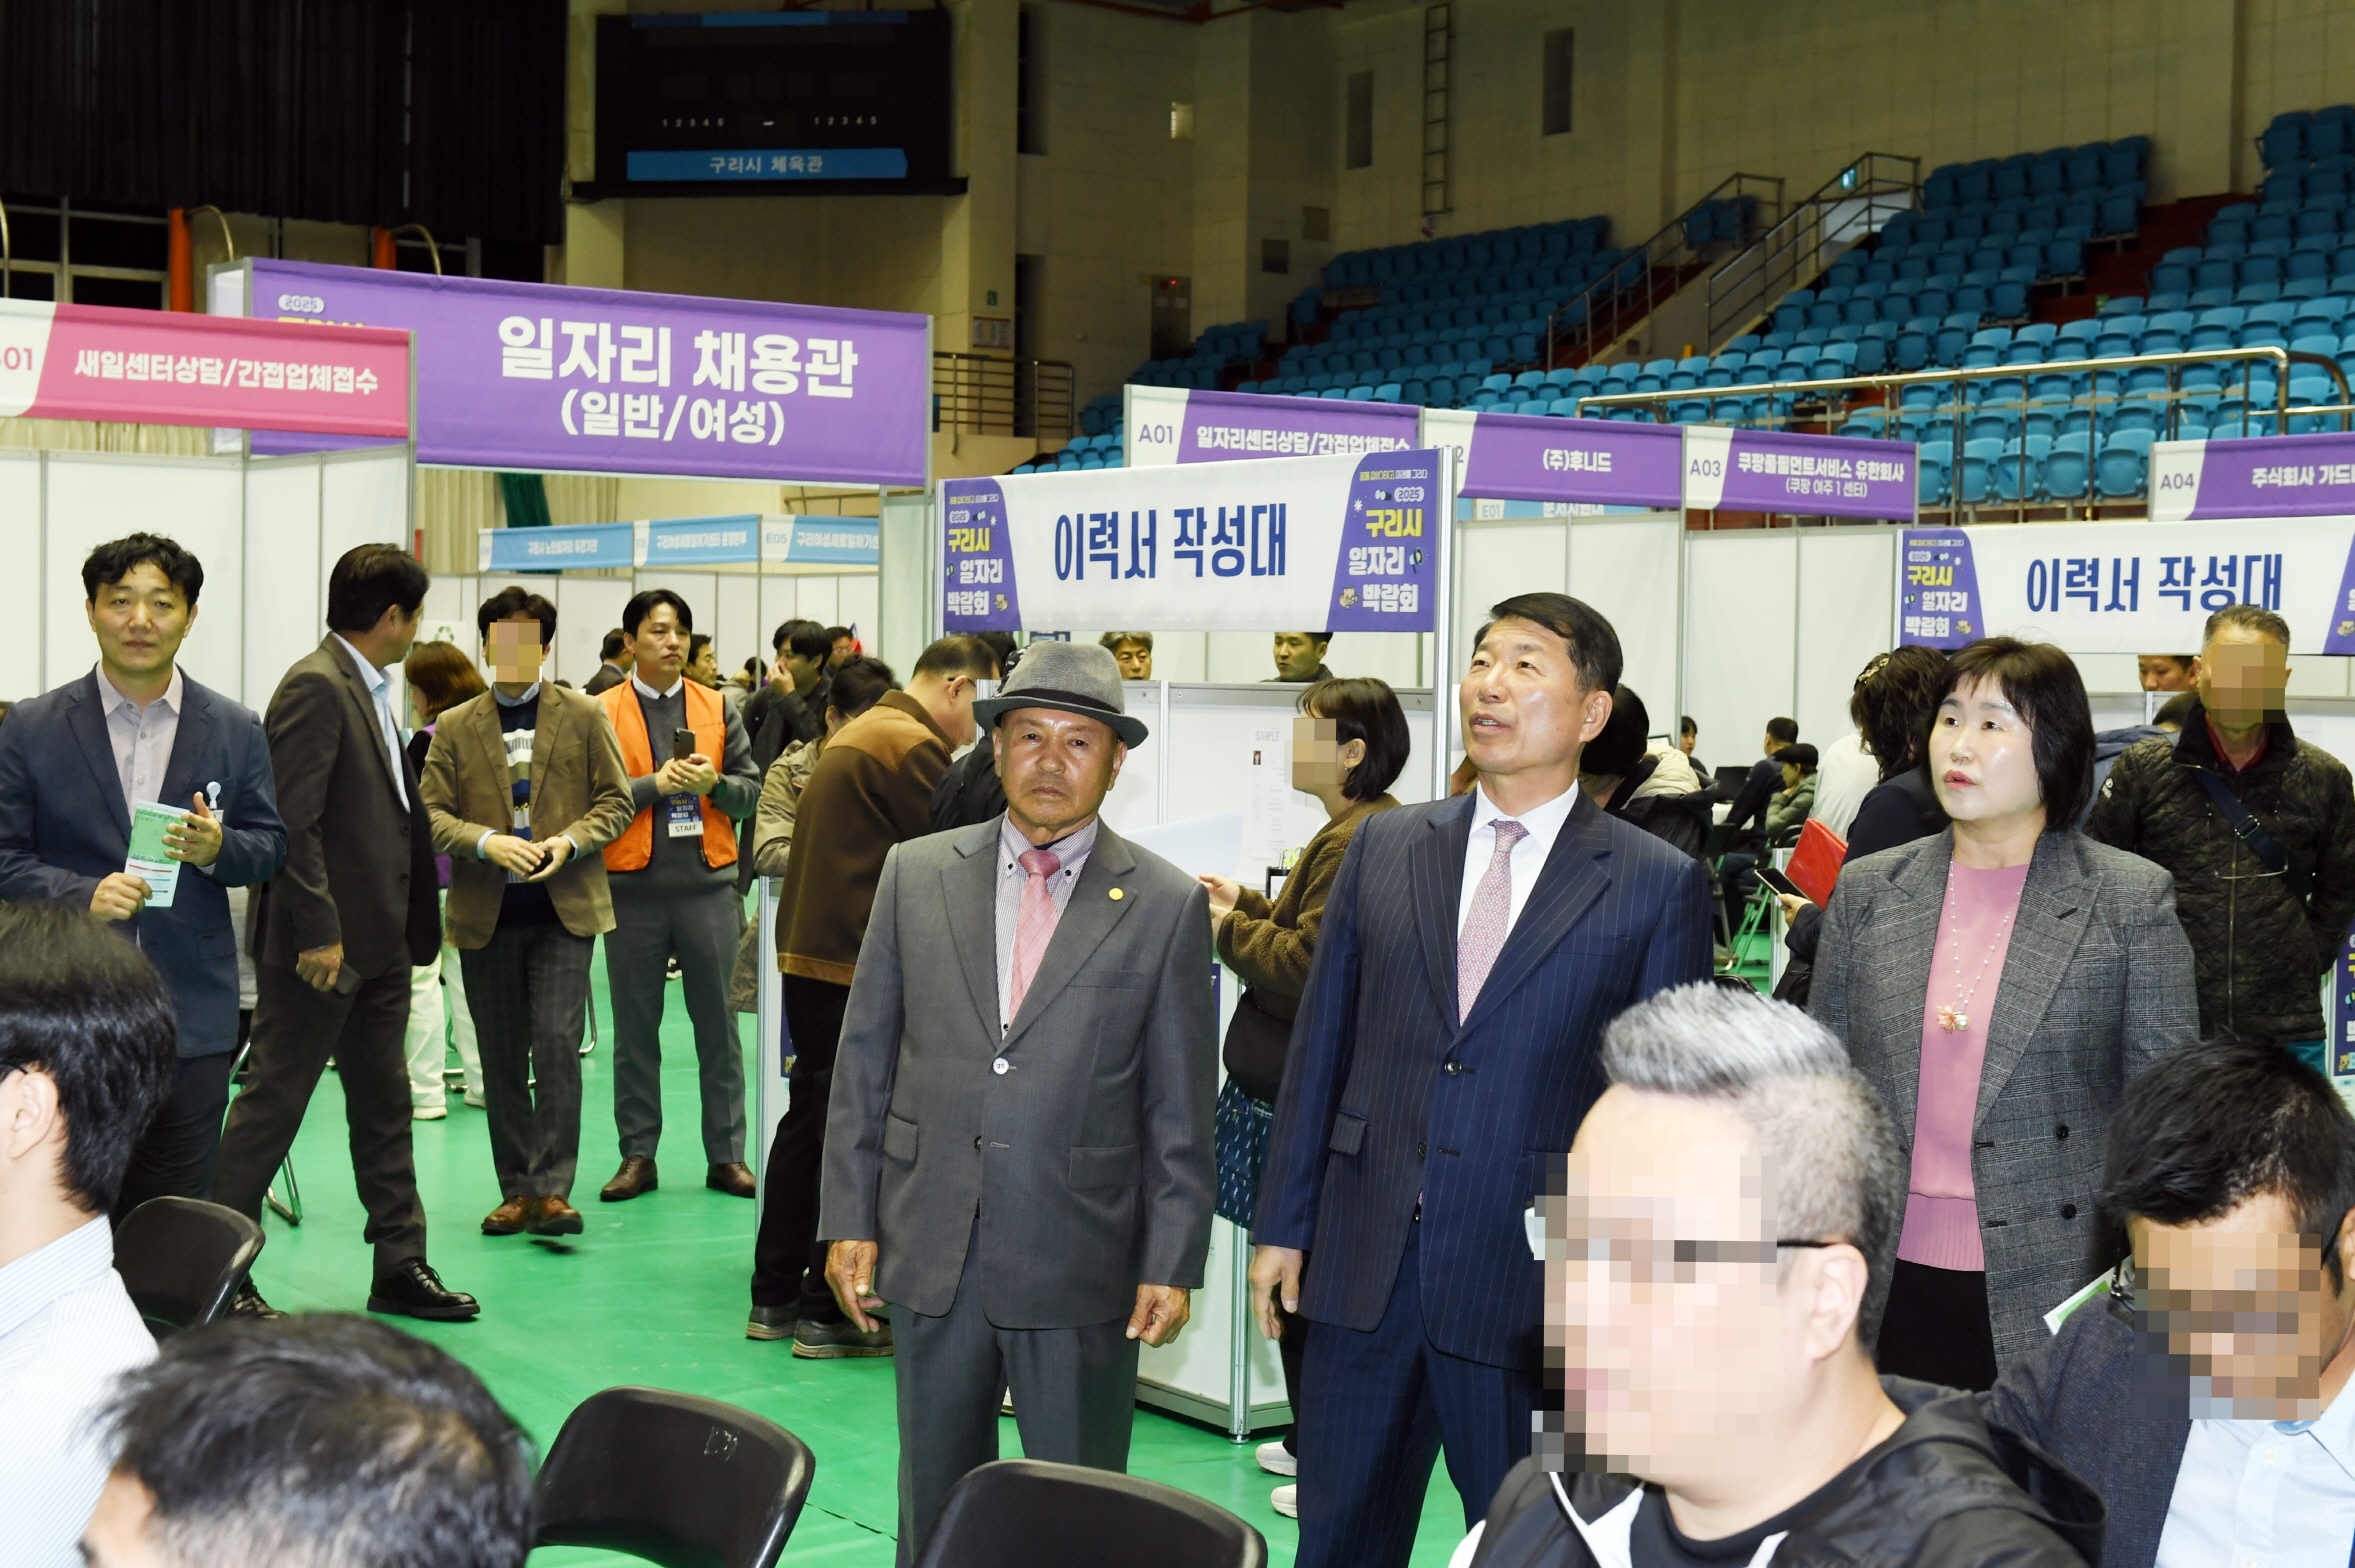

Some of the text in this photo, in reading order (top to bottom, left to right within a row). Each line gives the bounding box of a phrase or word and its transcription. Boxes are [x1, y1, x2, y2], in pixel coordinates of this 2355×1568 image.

[709, 155, 824, 174] 구리시 체육관
[498, 315, 859, 399] 일자리 채용관
[74, 350, 378, 395] 새일센터상담/간접업체접수
[560, 388, 786, 447] (일반/여성)
[1138, 424, 1174, 445] A01
[1542, 448, 1612, 472] (주)후니드
[1689, 459, 1721, 477] A03
[1737, 451, 1905, 482] 쿠팡풀필먼트서비스 유한회사
[1785, 476, 1811, 495] (쿠팡
[1843, 480, 1868, 498] 센터)
[2159, 473, 2195, 490] A04
[2251, 464, 2355, 489] 주식회사 가드
[1397, 488, 1422, 500] 2025
[1365, 508, 1423, 537] 구리시
[766, 532, 788, 544] E05
[948, 527, 990, 553] 구리시
[1054, 502, 1288, 581] 이력서 작성대
[959, 558, 1003, 584] 일자리
[1348, 546, 1405, 576] 일자리
[1907, 565, 1954, 587] 구리시
[2026, 553, 2283, 613] 이력서 작성대
[947, 590, 990, 616] 박람회
[1362, 582, 1419, 613] 박람회
[1922, 590, 1968, 613] 일자리
[1904, 615, 1950, 638] 박람회
[675, 824, 697, 832] STAFF
